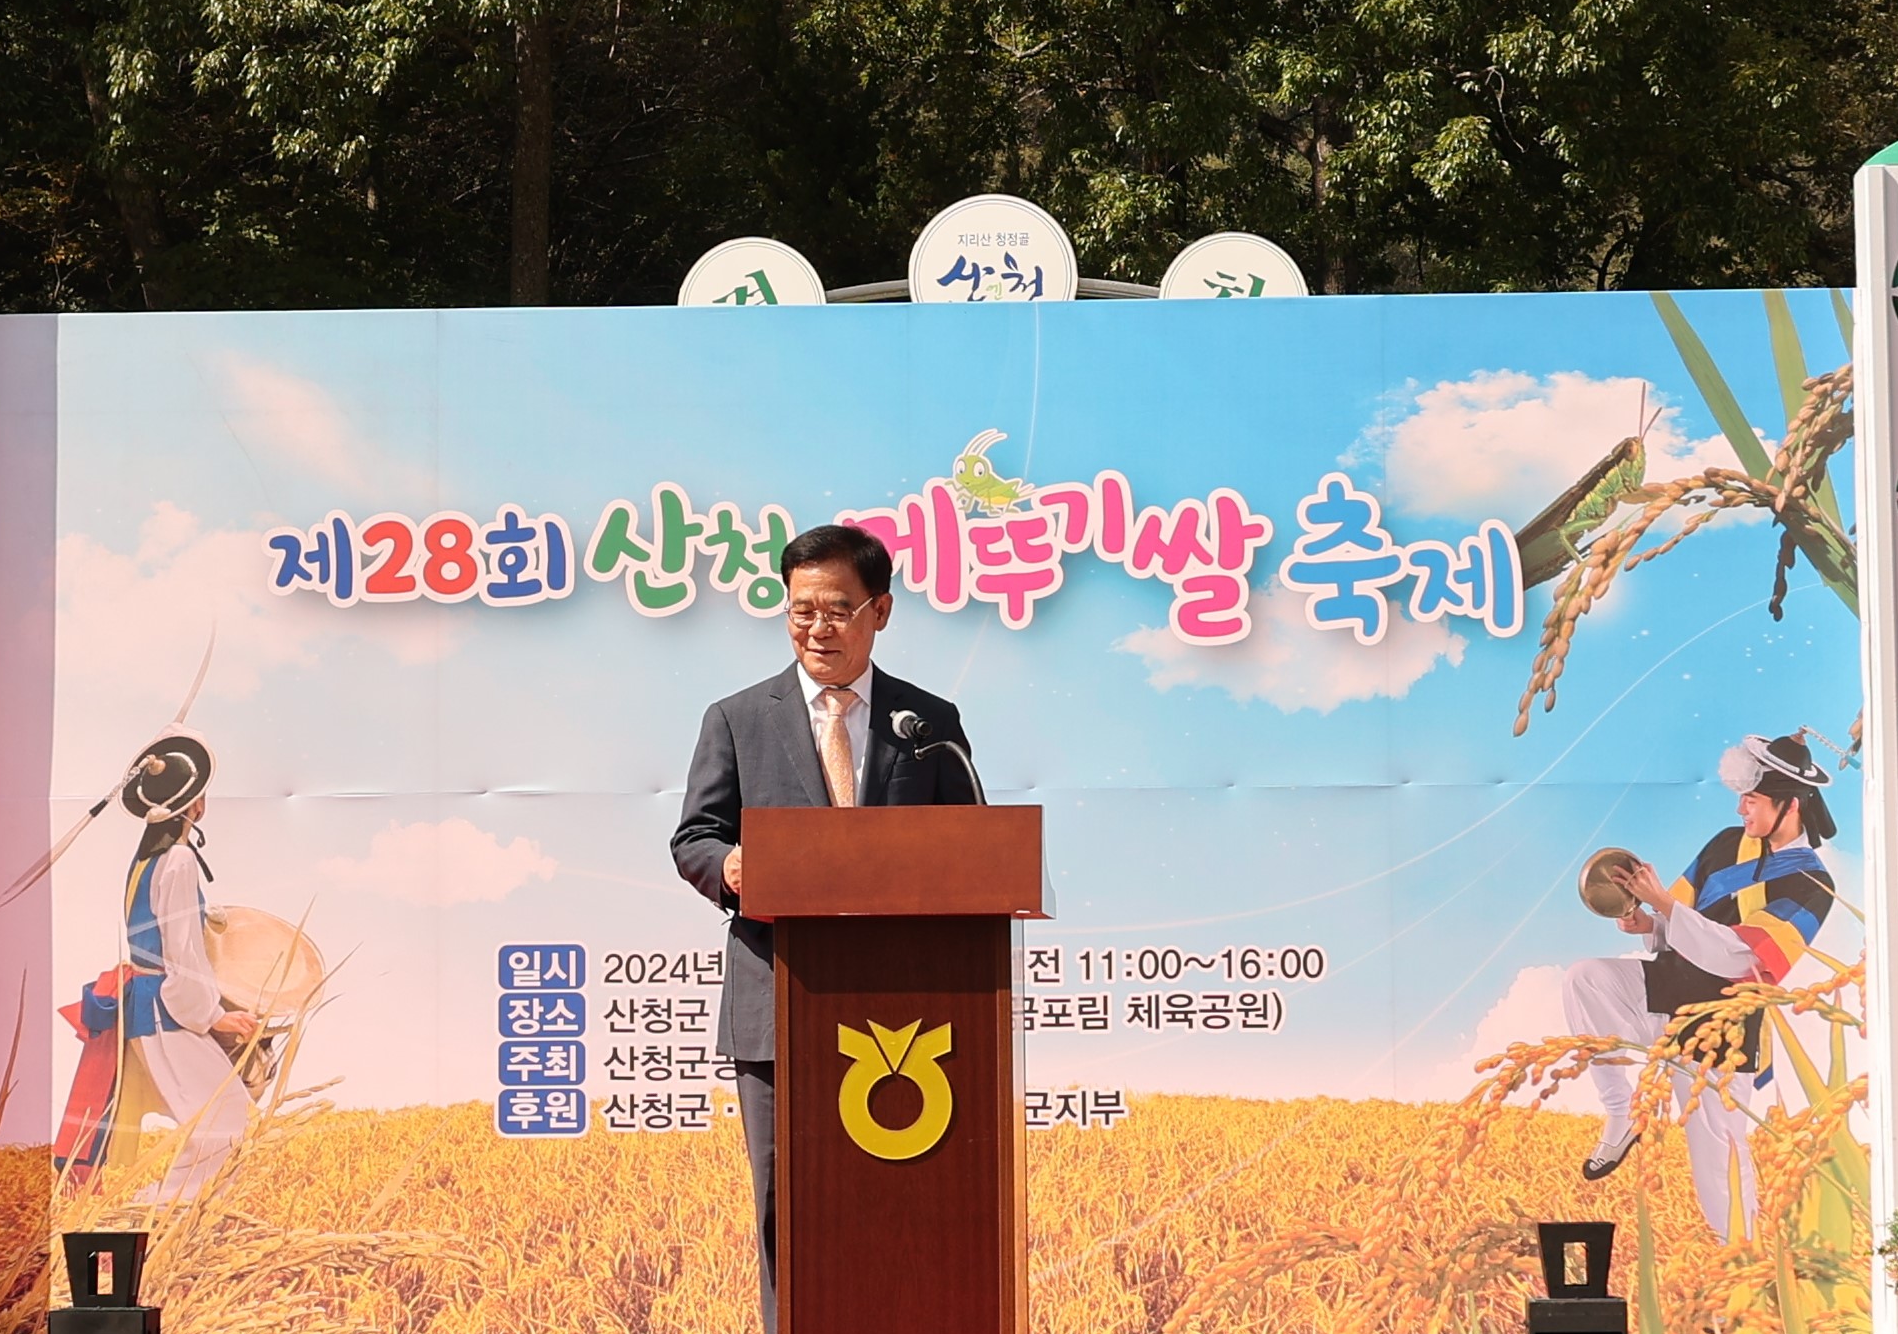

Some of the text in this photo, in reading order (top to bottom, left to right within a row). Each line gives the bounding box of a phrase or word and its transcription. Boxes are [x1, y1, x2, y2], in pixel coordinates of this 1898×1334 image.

[958, 232, 1030, 247] 지리산 청정골
[269, 475, 1519, 641] 제28회 산청 메뚜기쌀 축제
[508, 950, 578, 987] 일시
[603, 951, 724, 985] 2024년
[1079, 948, 1325, 981] 11:00~16:00
[507, 998, 579, 1035] 장소
[603, 998, 710, 1034] 산청군
[1126, 992, 1283, 1030] 체육공원)
[507, 1046, 578, 1082] 주최
[507, 1093, 579, 1129] 후원
[603, 1093, 711, 1128] 산청군
